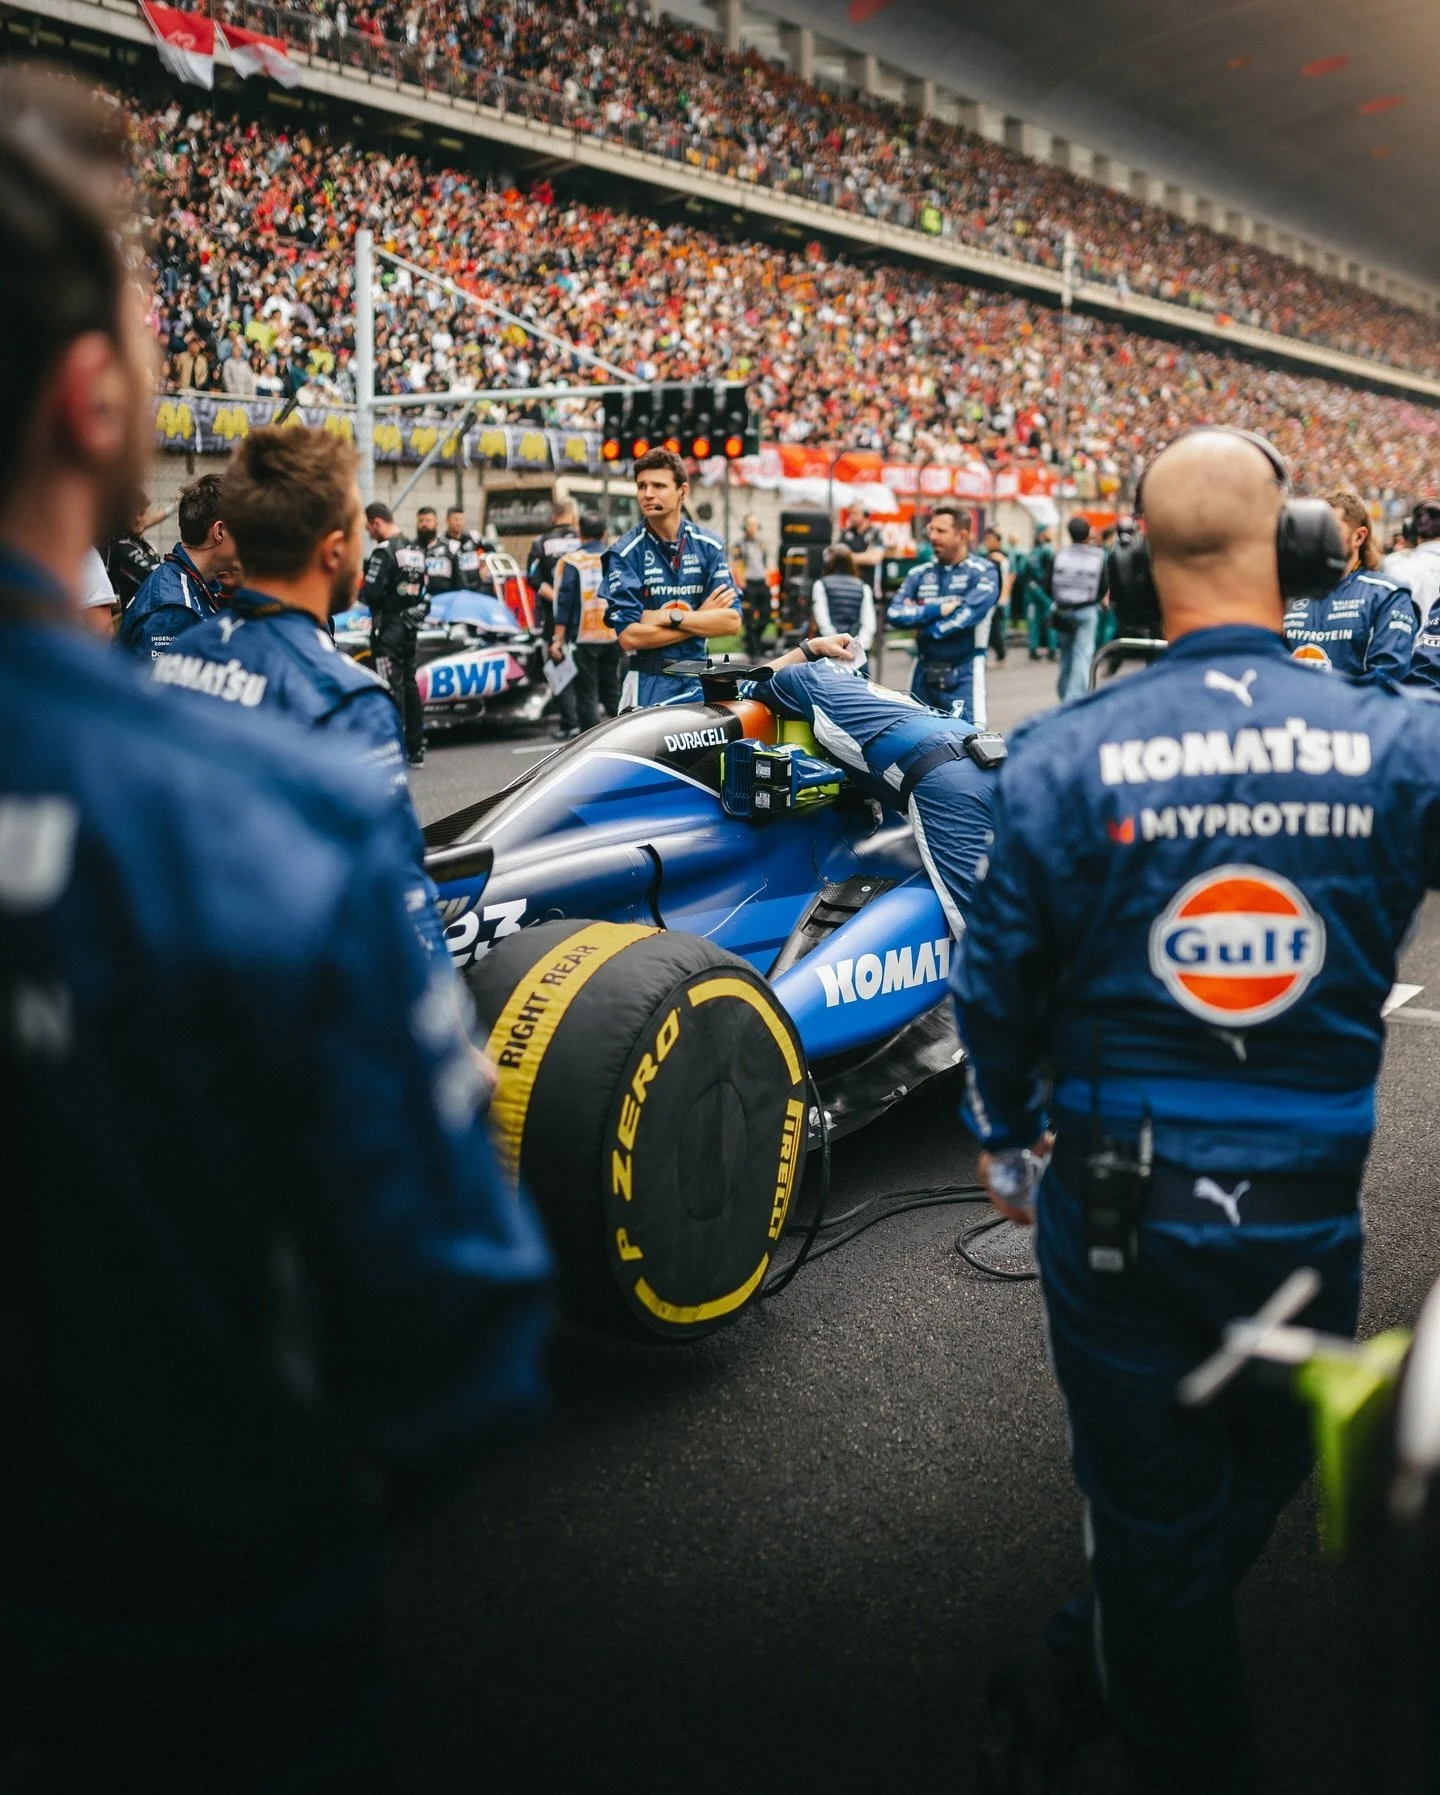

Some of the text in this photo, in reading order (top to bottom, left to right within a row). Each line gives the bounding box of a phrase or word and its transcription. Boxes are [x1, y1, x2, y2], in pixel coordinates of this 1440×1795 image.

[1286, 629, 1353, 642] MYPROTEIN
[431, 660, 505, 699] BWT
[663, 727, 729, 752] DURACELL
[1100, 717, 1373, 786] KOMATSU
[1140, 802, 1375, 842] MYPROTEIN
[1165, 927, 1309, 966] Gulf
[498, 945, 599, 1070] RIGHT REAR
[611, 1008, 681, 1261] P ZERO
[767, 1098, 805, 1241] PIRELLI
